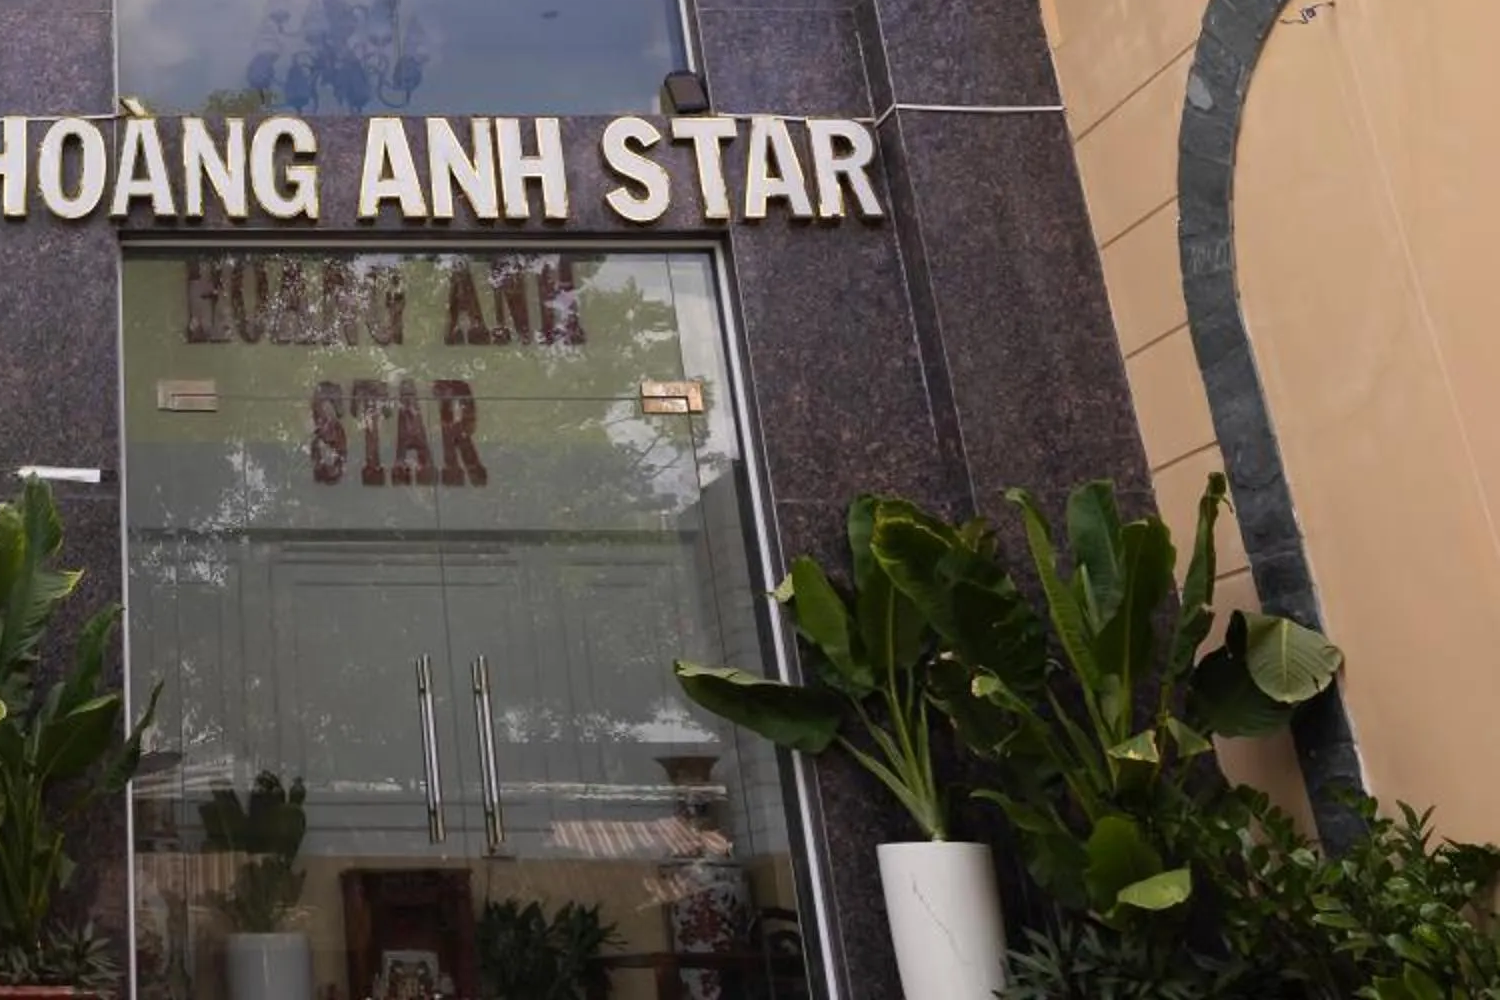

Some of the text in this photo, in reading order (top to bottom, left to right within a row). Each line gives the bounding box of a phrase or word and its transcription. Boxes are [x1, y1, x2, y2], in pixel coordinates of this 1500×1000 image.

[358, 116, 570, 221] ANH
[600, 116, 886, 222] STAR
[310, 379, 489, 487] STAR
